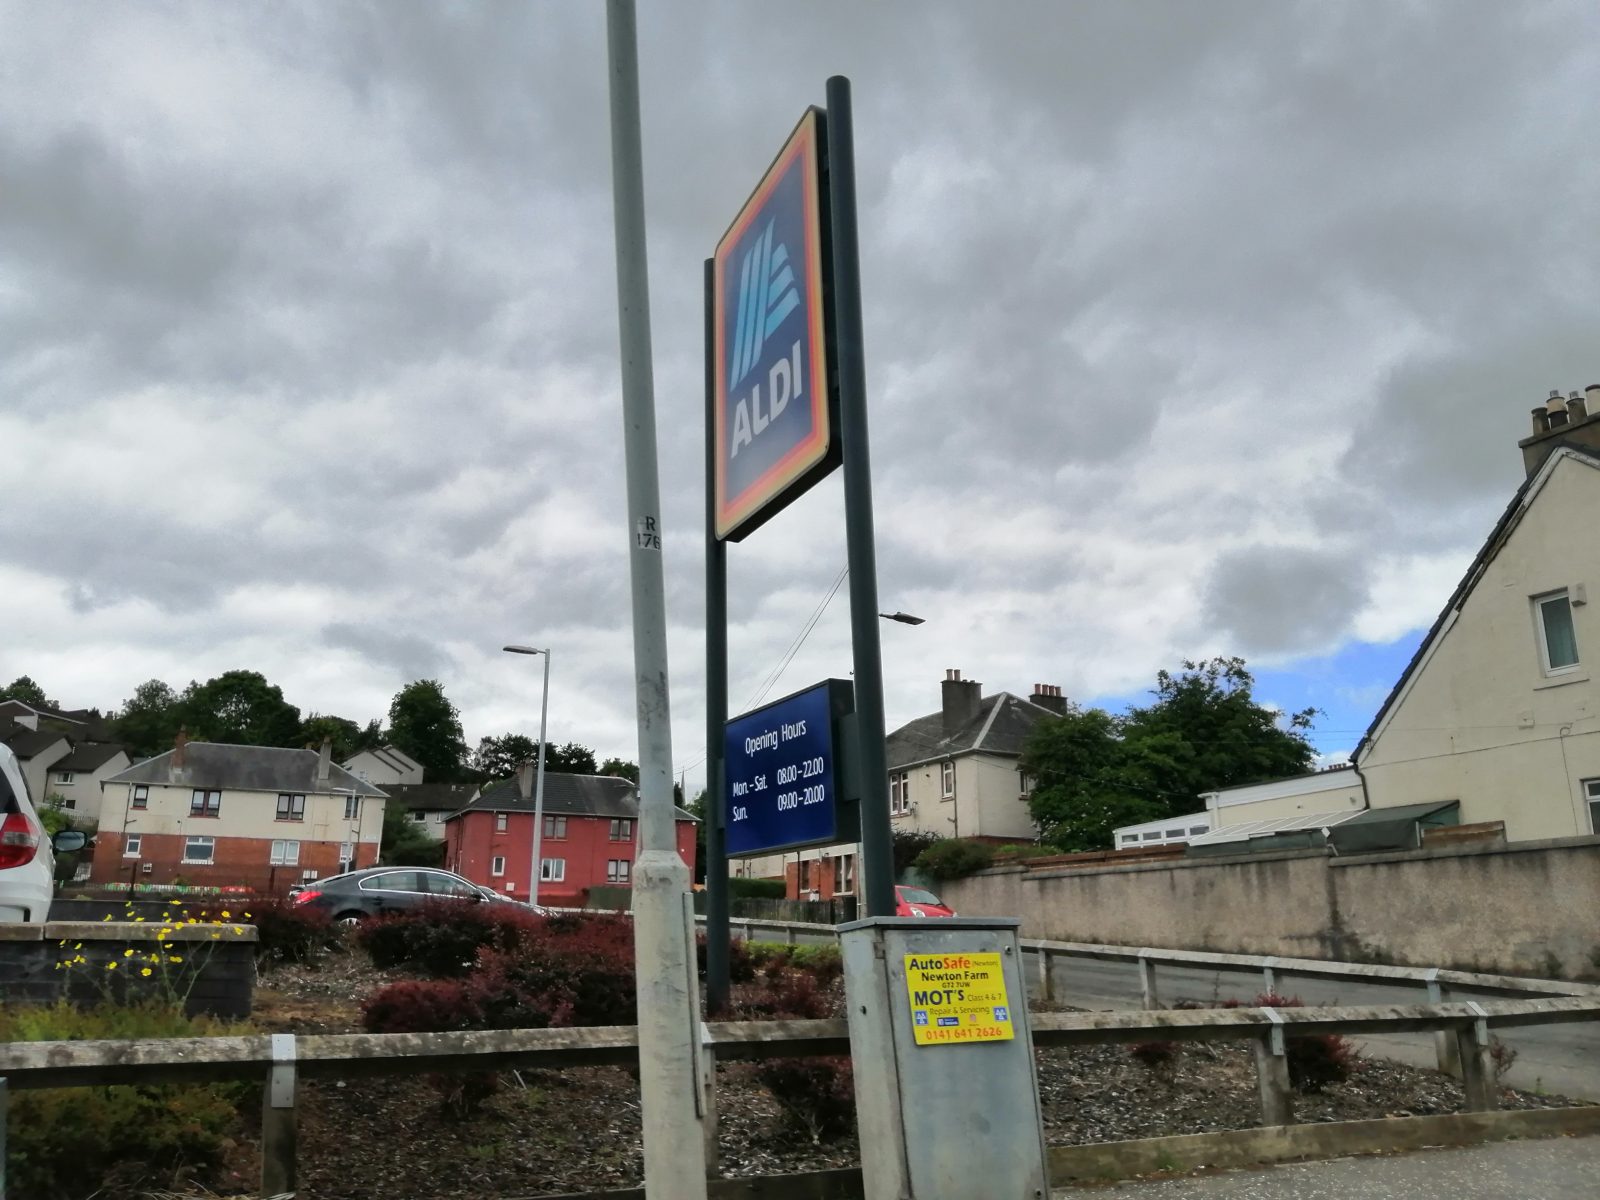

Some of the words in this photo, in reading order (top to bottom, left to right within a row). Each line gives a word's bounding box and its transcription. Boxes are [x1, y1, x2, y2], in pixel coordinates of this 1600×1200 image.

[730, 338, 802, 460] ALDI
[646, 516, 656, 531] R
[745, 730, 778, 757] Opening
[781, 720, 807, 742] Hours
[733, 806, 748, 822] Sun.
[909, 957, 970, 970] AutoSafe
[921, 971, 962, 981] Newton
[964, 971, 989, 980] Farm
[967, 994, 984, 1002] Class
[930, 1007, 952, 1016] Repair
[959, 1005, 990, 1015] Servicing
[926, 1030, 951, 1041] 0141
[954, 1029, 974, 1038] 641
[976, 1027, 1002, 1038] 2626
